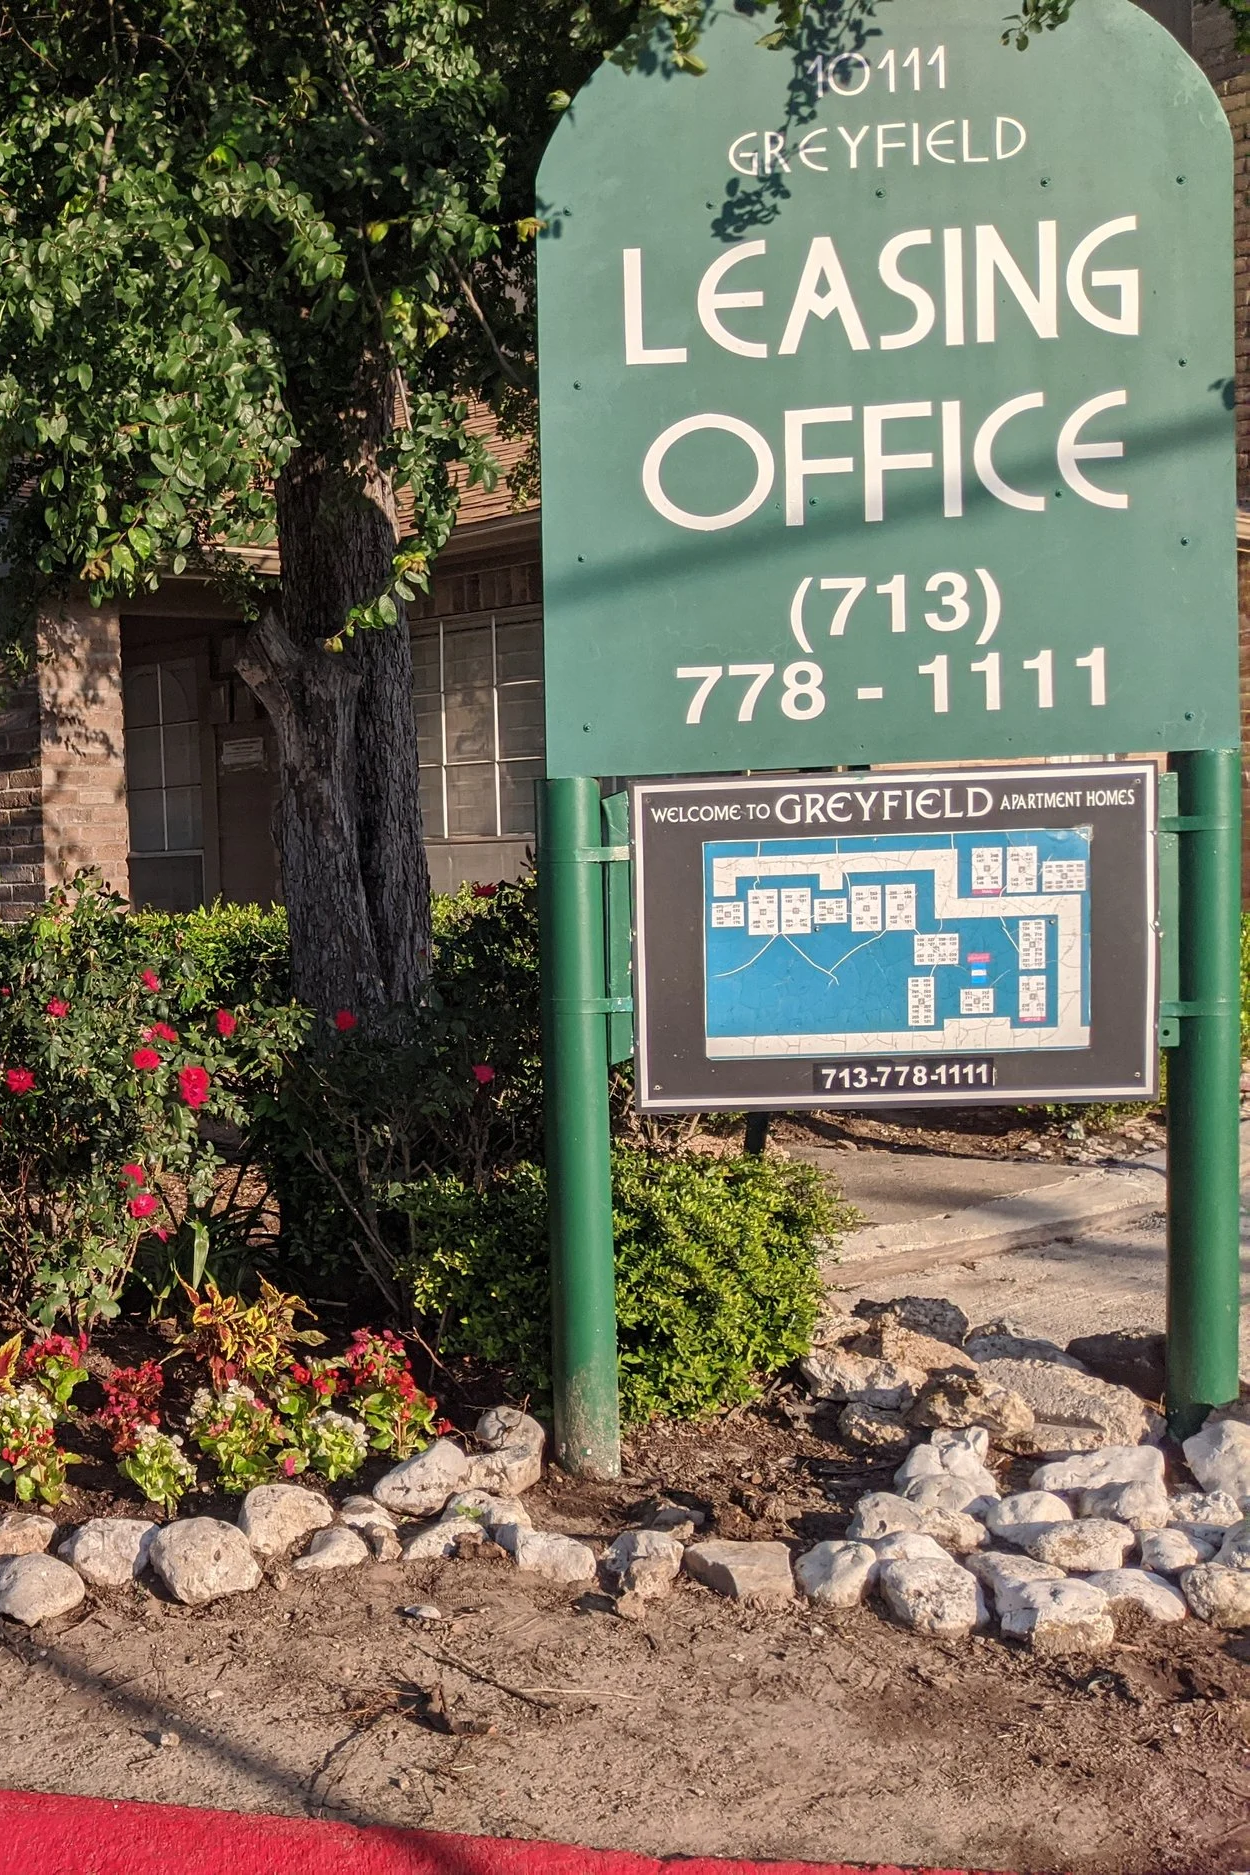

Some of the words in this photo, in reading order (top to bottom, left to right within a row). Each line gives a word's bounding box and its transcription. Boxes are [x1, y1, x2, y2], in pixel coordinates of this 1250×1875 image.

[807, 45, 946, 97] 10111
[729, 116, 1027, 176] GREYFIELD
[623, 216, 1139, 365] LEASING
[643, 390, 1128, 531] OFFICE
[790, 568, 1001, 653] (713)
[677, 661, 826, 724] 778
[918, 647, 1106, 713] 1111
[650, 805, 741, 823] WELCOME
[746, 803, 770, 820] TO
[775, 787, 994, 825] GREYFIELD
[1000, 791, 1083, 810] APARTMENT
[1086, 788, 1135, 807] HOMES
[821, 1062, 989, 1089] 713-778-1111
